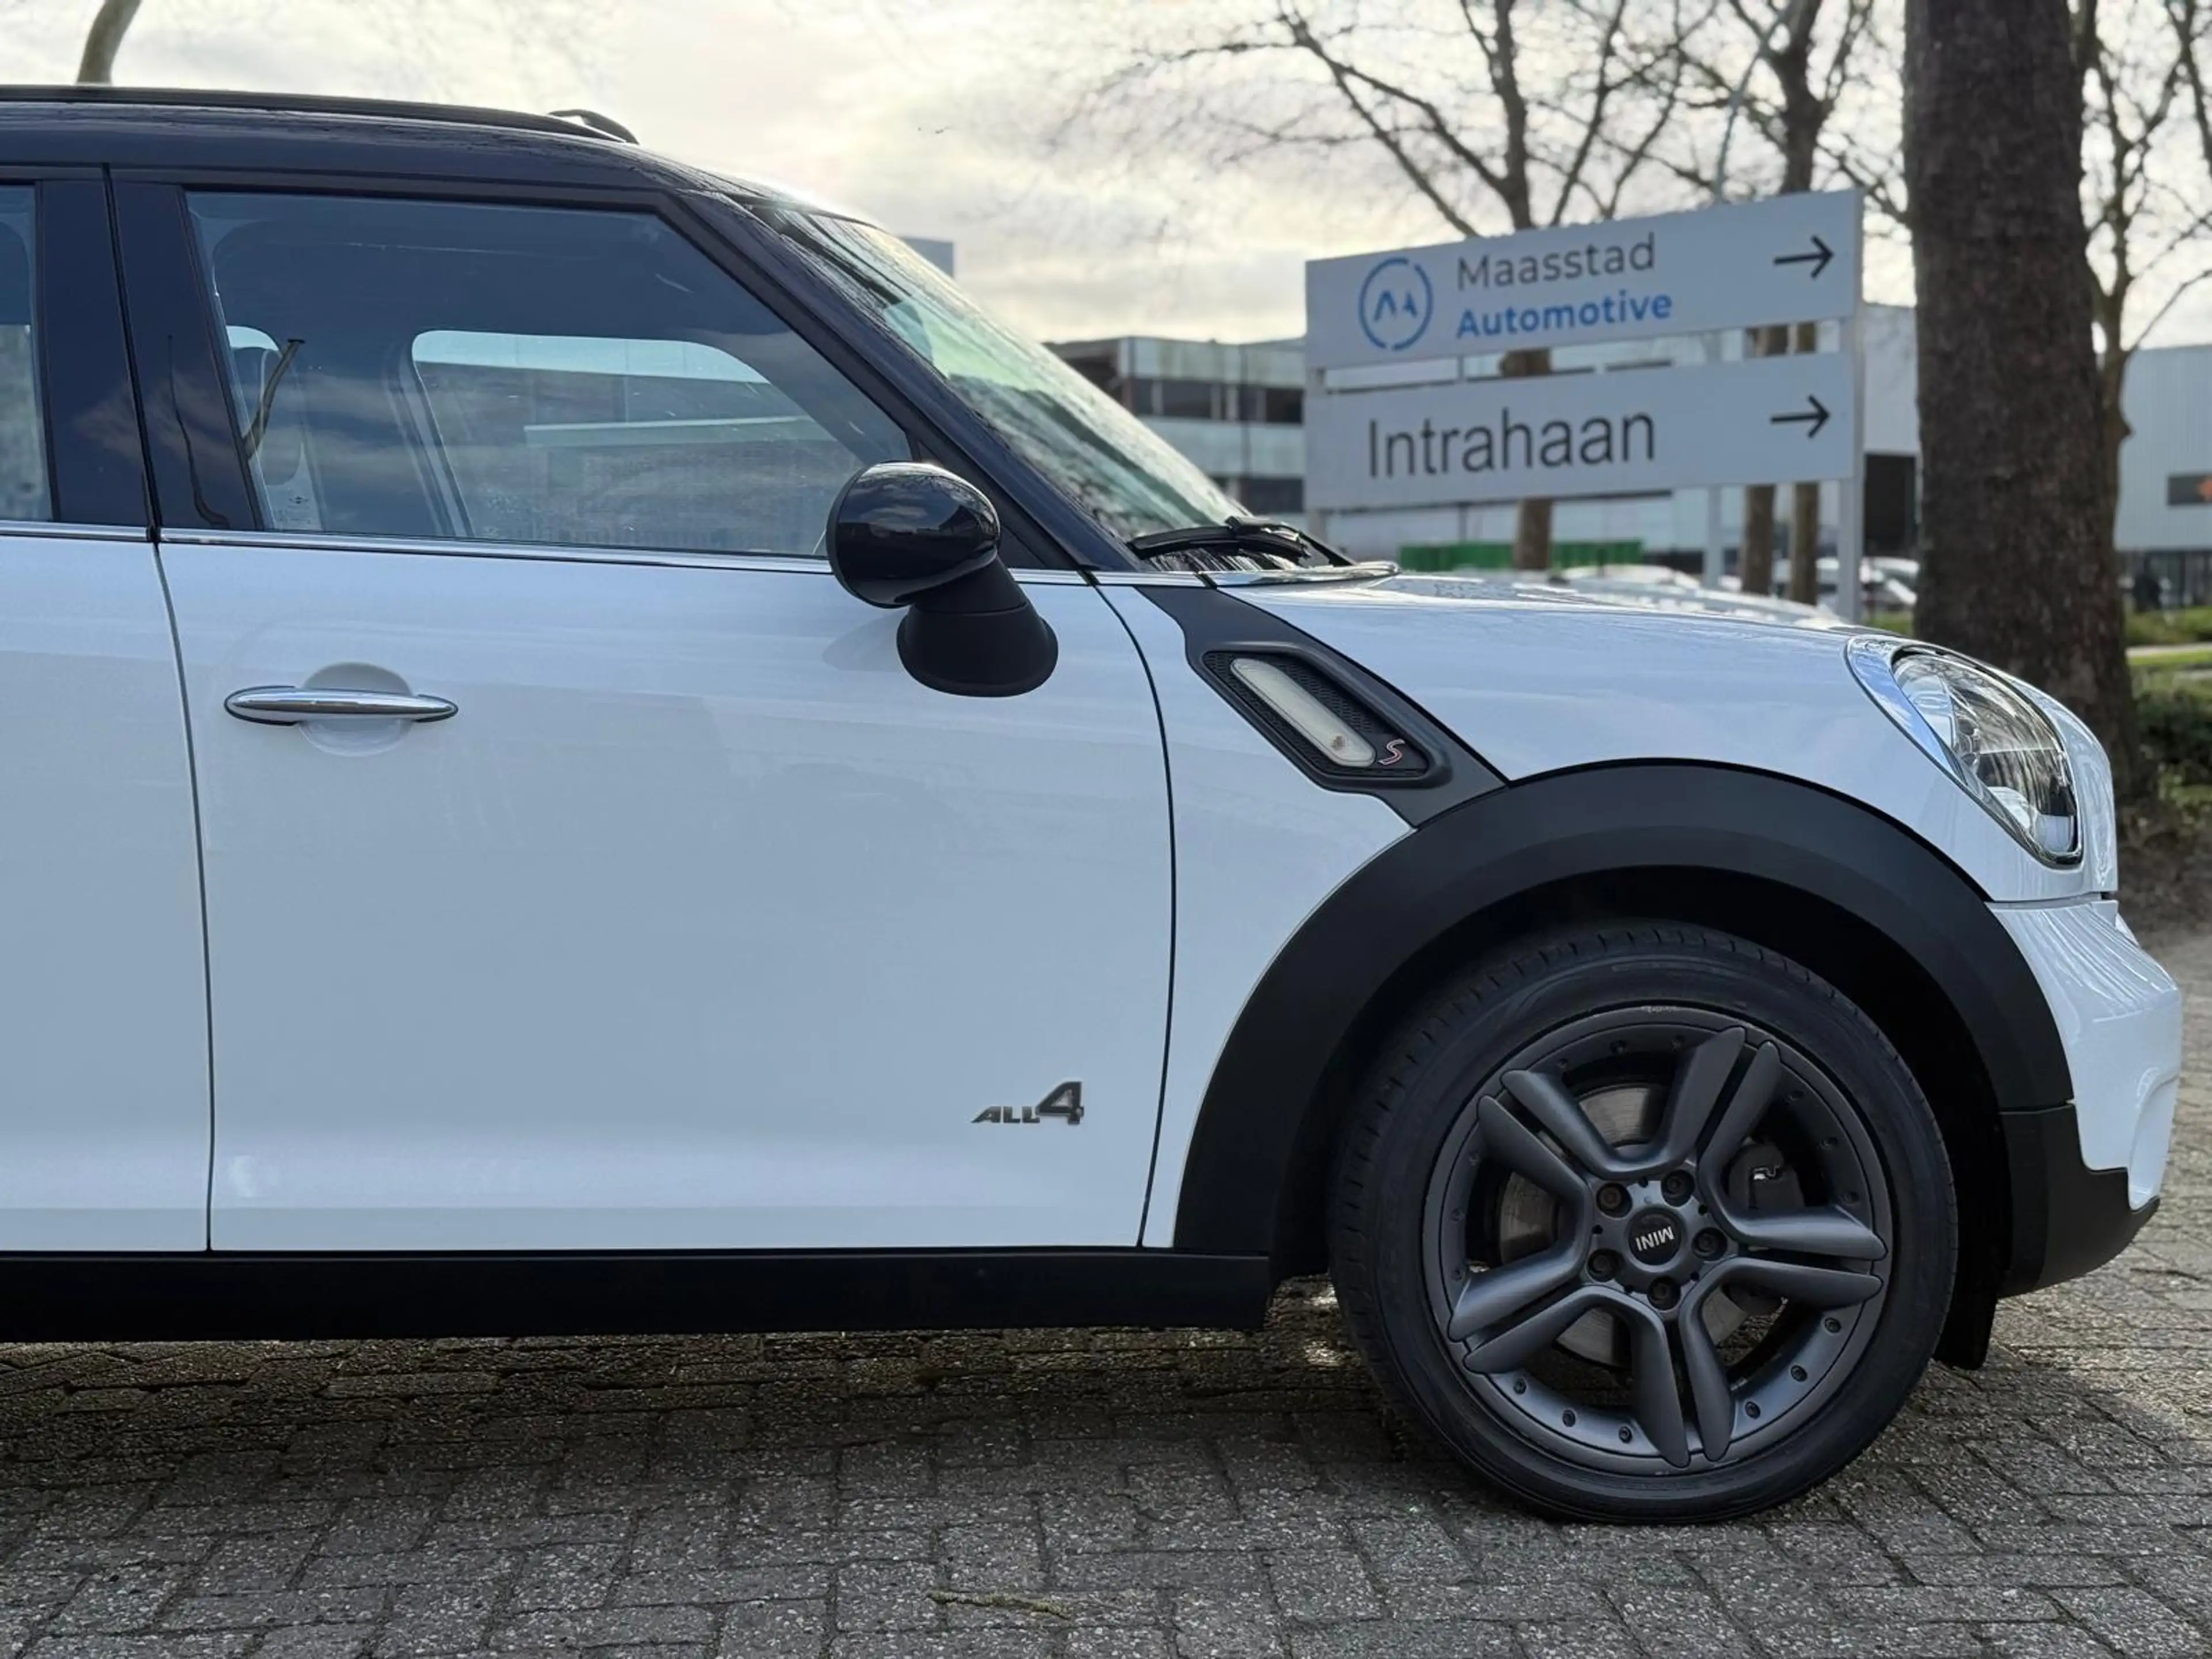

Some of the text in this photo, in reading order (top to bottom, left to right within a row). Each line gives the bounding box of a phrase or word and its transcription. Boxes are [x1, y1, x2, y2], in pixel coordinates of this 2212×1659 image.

[1457, 232, 1655, 290] Maasstad
[1456, 289, 1673, 339] Automotive
[1369, 407, 1655, 478] Intrahaan
[1378, 738, 1406, 765] S
[971, 1081, 1084, 1126] ALL4
[1635, 1226, 1675, 1252] MINI
